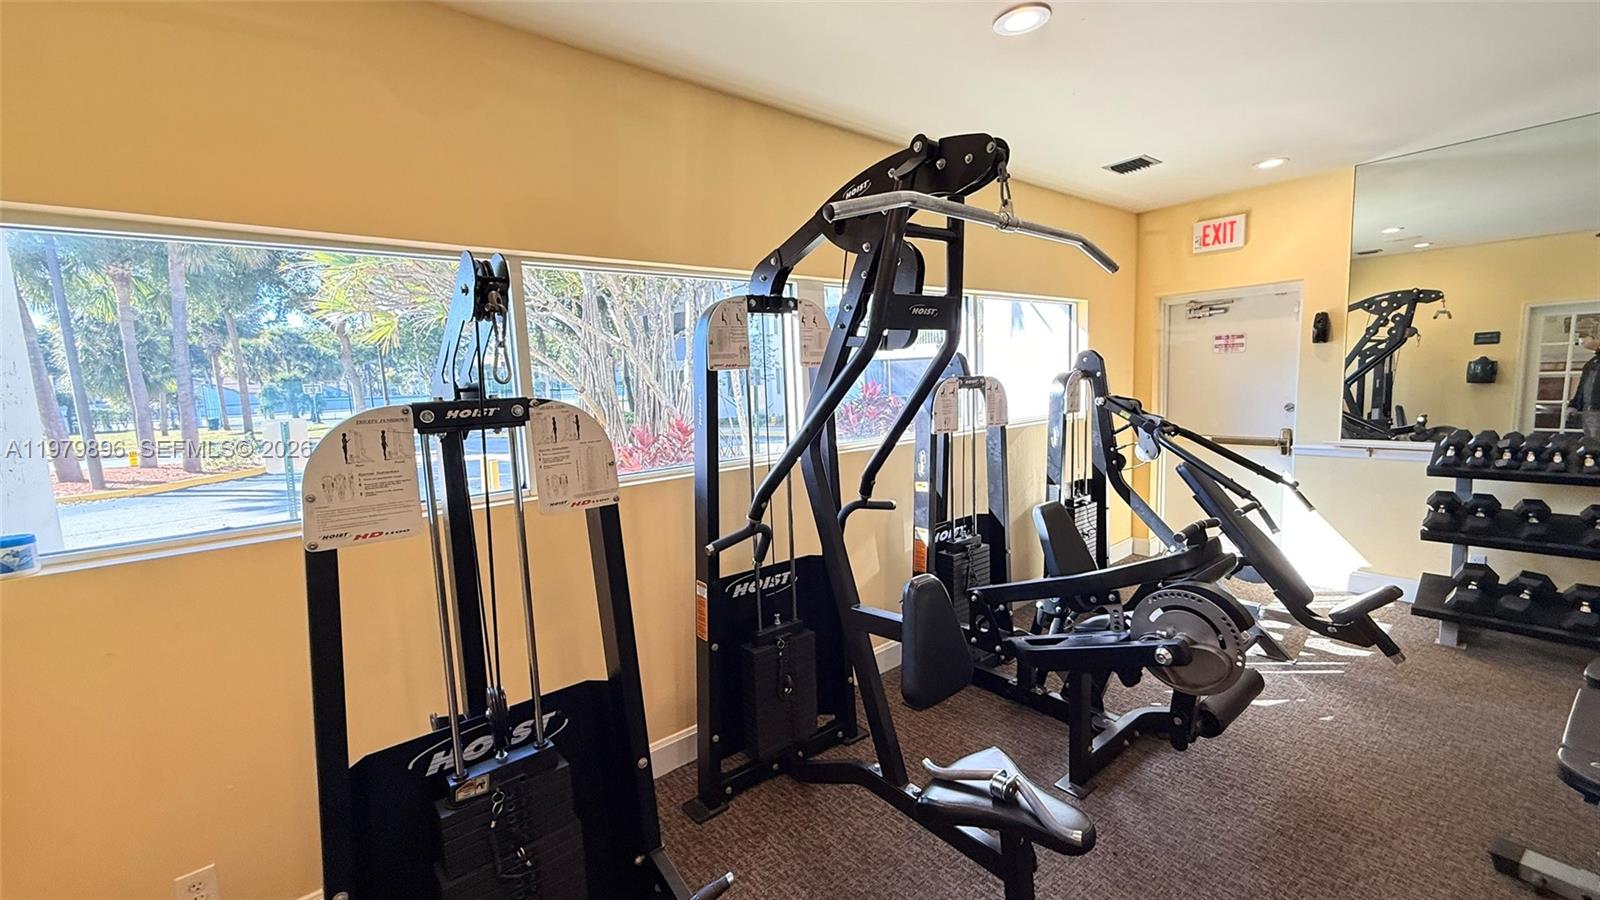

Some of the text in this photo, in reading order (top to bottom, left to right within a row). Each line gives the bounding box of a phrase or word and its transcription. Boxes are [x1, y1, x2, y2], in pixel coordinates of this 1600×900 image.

[845, 179, 870, 199] HOIST
[1203, 220, 1237, 247] EXIT
[911, 307, 938, 315] HOIST
[571, 499, 591, 507] HD
[322, 532, 349, 541] HOIST
[353, 531, 384, 541] HD
[732, 571, 792, 598] HOIST
[424, 711, 557, 777] HOST
